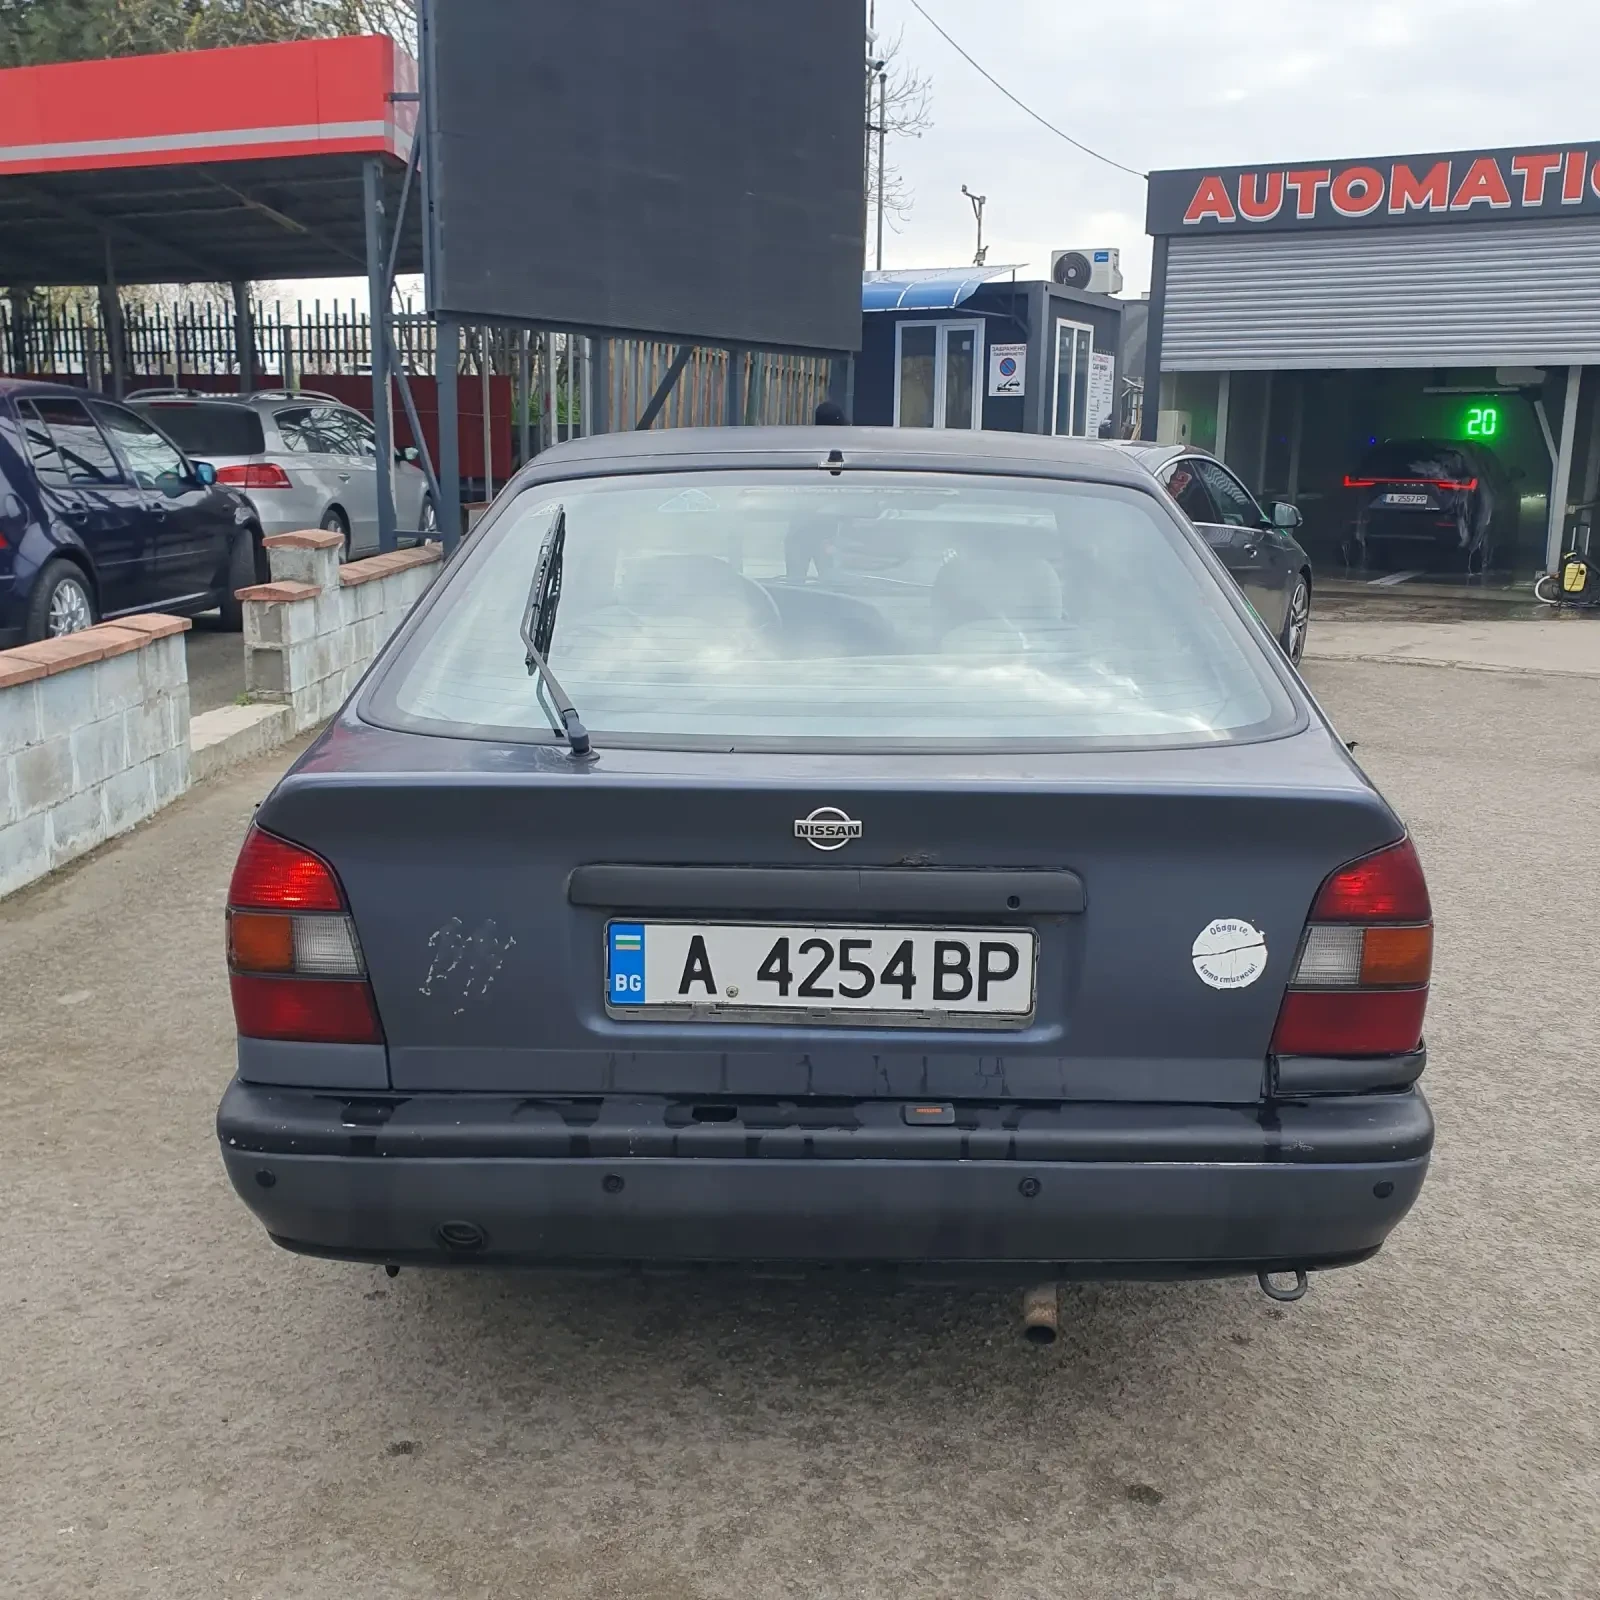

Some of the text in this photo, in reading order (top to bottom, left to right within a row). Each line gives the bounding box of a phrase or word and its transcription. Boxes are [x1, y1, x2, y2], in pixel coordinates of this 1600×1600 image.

[1183, 151, 1600, 224] AUTOMATI
[1467, 408, 1497, 435] 20
[796, 824, 862, 837] NISSAN
[678, 934, 718, 995] A
[615, 973, 642, 992] BG
